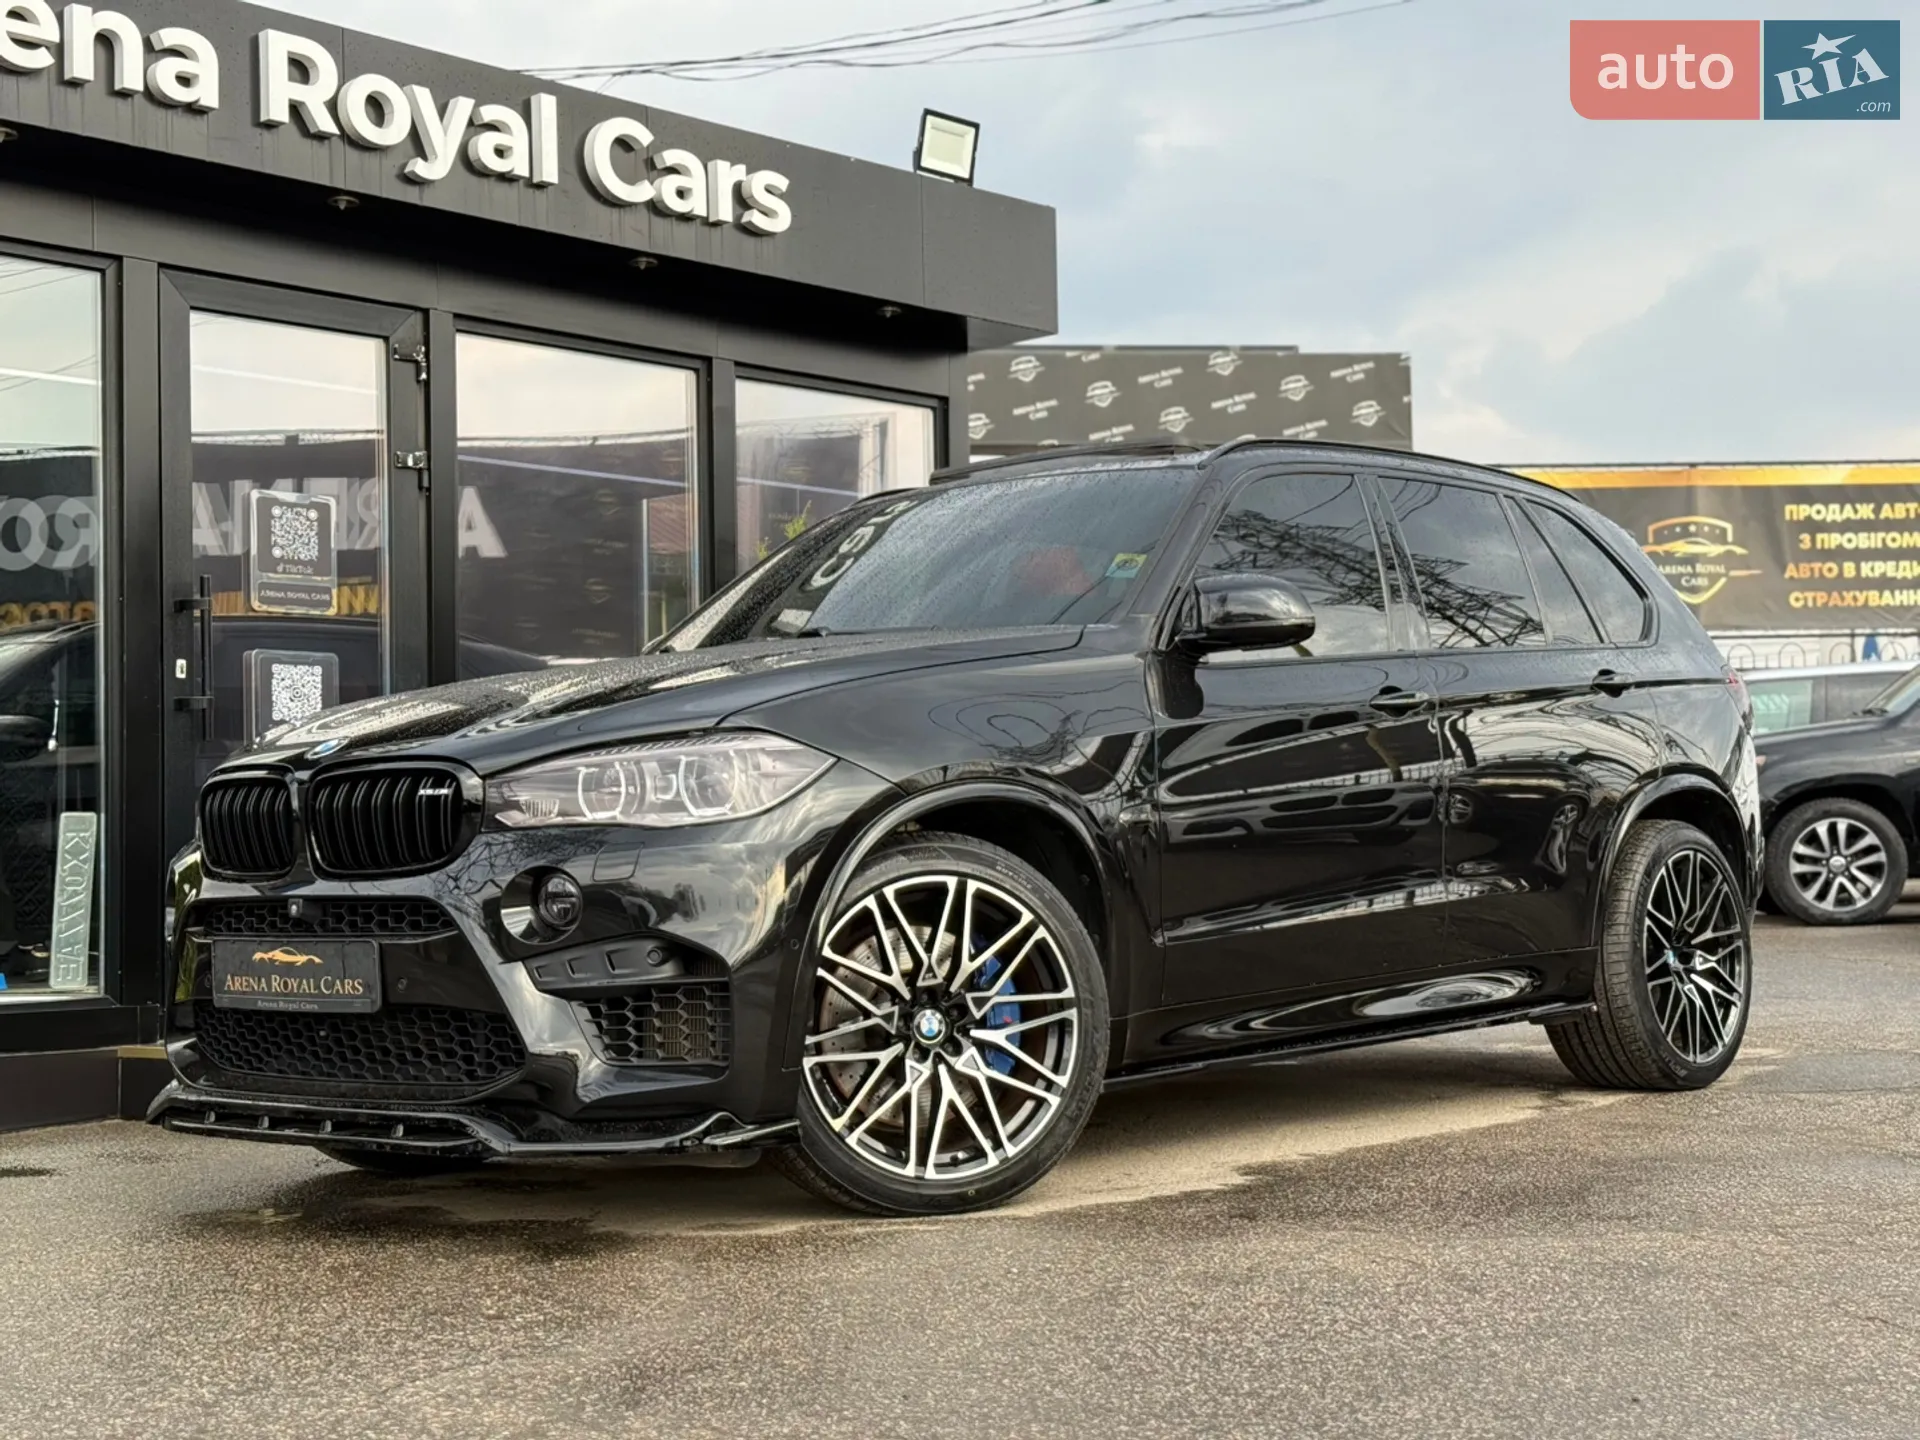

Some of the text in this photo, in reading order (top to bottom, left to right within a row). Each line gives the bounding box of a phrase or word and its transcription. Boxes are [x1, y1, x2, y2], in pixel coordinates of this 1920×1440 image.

[257, 28, 558, 187] Royal
[584, 116, 791, 235] Cars
[1784, 502, 1920, 522] ПРОДАЖ АВТ
[1815, 531, 1920, 550] ПРОБІГОМ
[1784, 561, 1839, 579] АВТО
[1842, 561, 1857, 579] В
[224, 973, 363, 995] ARENA ROYAL CARS
